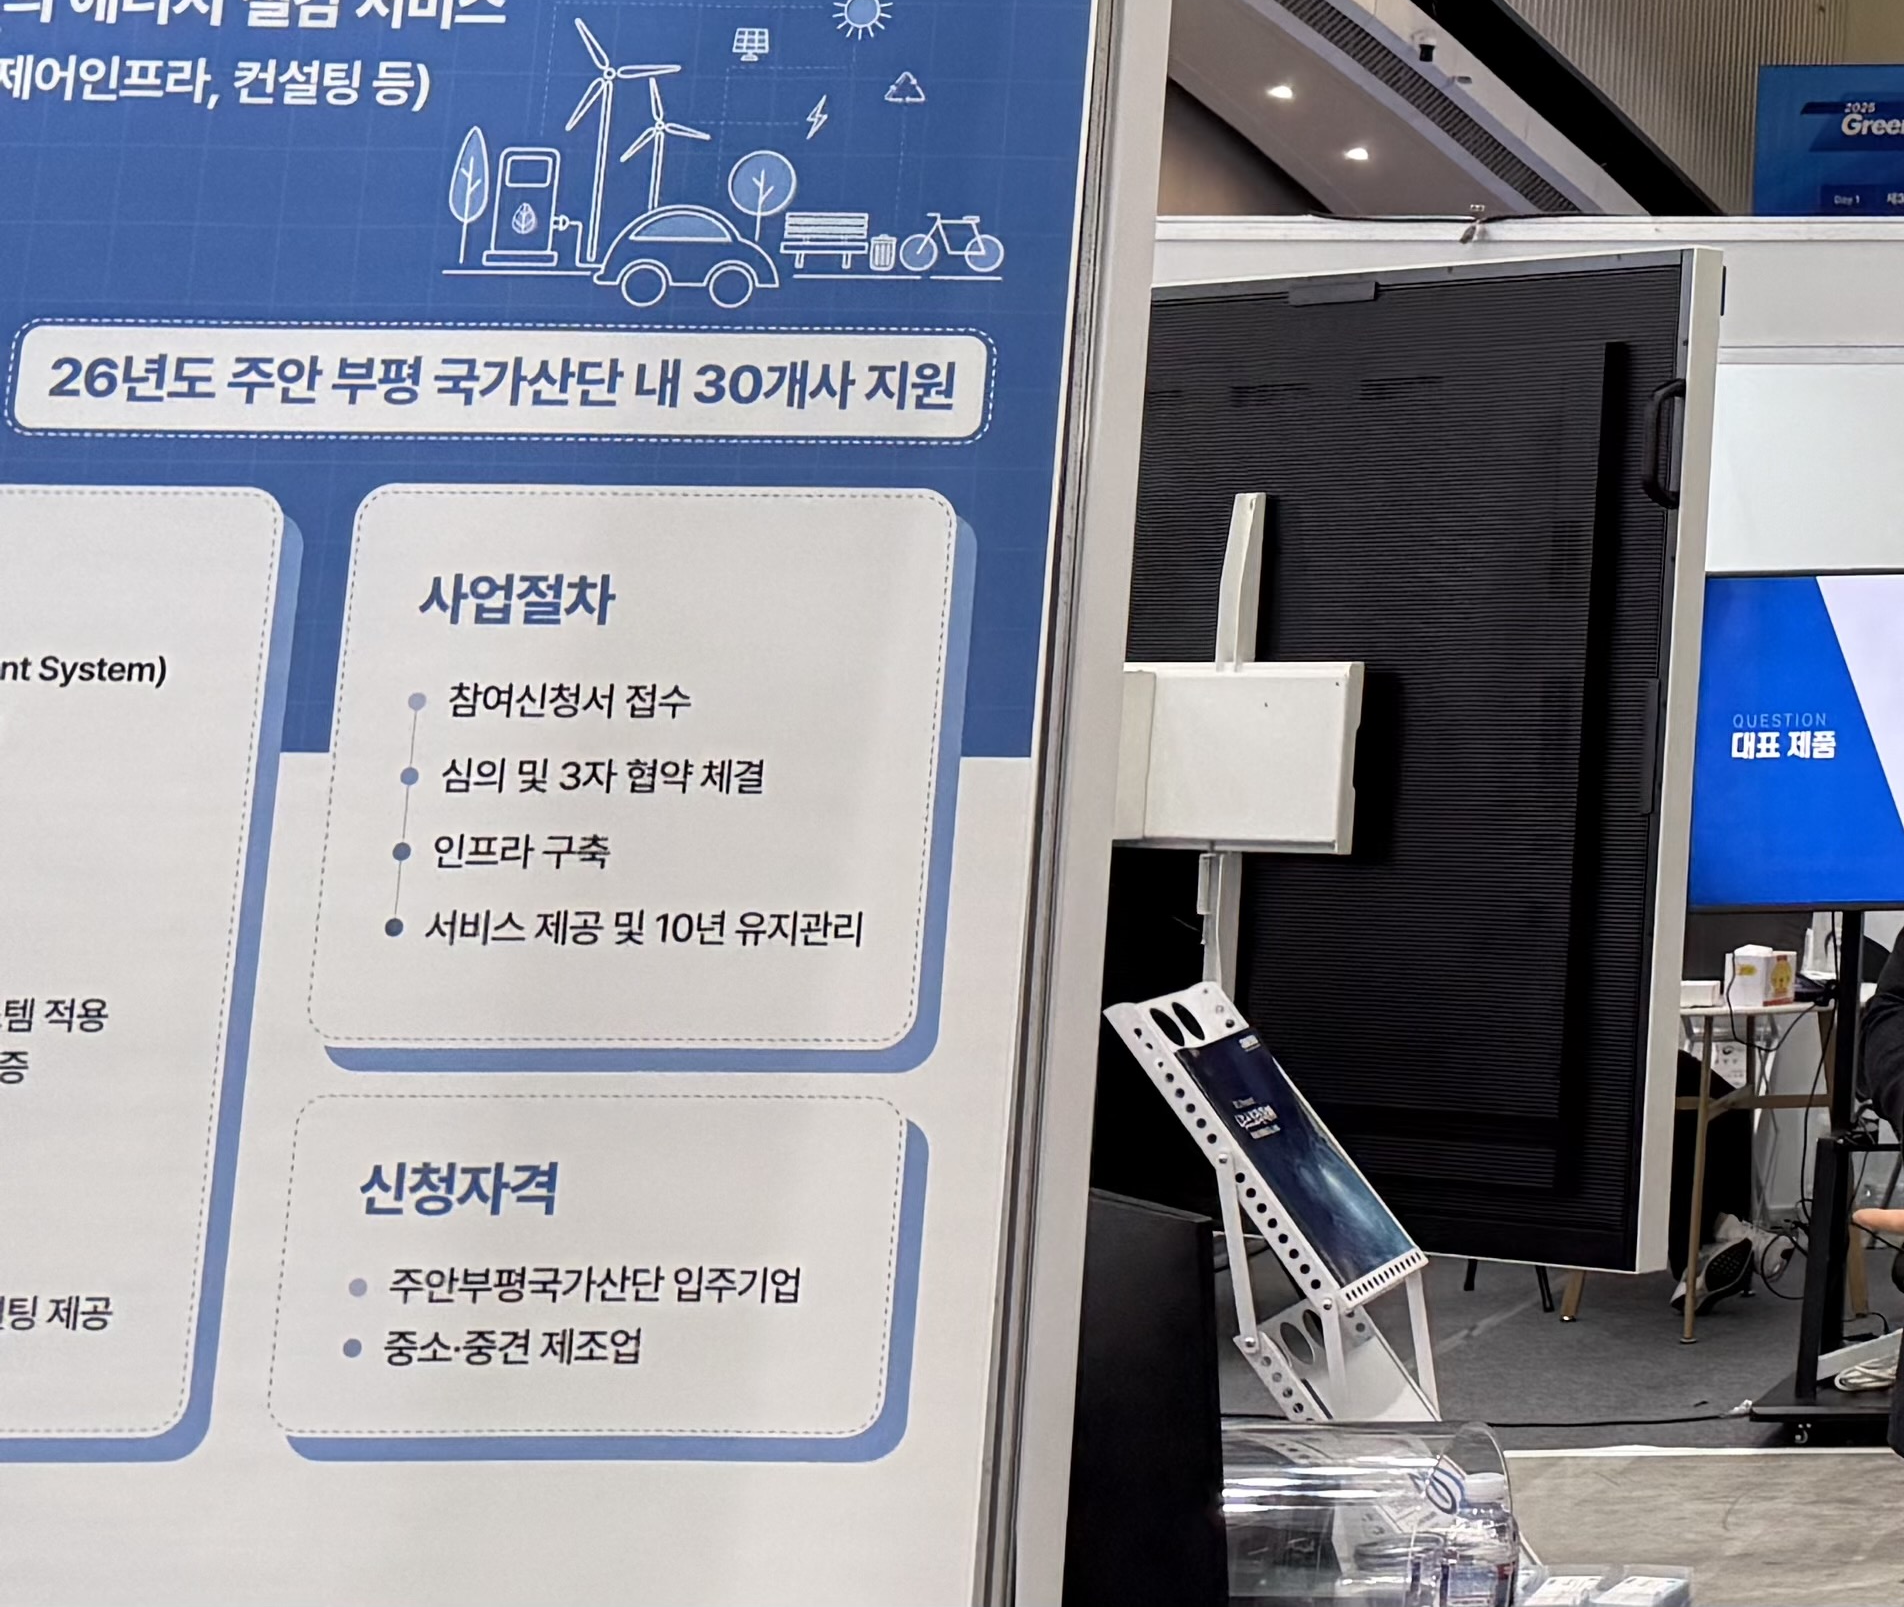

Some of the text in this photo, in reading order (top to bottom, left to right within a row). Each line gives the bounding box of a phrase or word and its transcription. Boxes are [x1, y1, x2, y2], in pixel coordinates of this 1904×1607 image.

[232, 57, 361, 105] 컨설팅
[371, 57, 431, 114] 등)
[49, 355, 955, 410] 26년도 주안 부평 국가산단 내 30개사 지원
[419, 574, 616, 626] 사업절차
[39, 654, 167, 689] System)
[448, 683, 691, 721] 참여신청서 접수
[1733, 713, 1826, 727] QUESTION
[1732, 731, 1836, 760] 대표 제품
[442, 758, 764, 795] 심의 및 3자 협약 체결
[433, 834, 610, 870] 인프라 구축
[425, 909, 863, 947] 서비스 제공 및 10년 유지관리
[44, 998, 108, 1033] 적용
[360, 1162, 557, 1215] 신청자격
[390, 1266, 801, 1306] 주안부평국가산단 입주기업
[46, 1296, 113, 1331] 제공
[384, 1328, 642, 1367] 중소·중견 제조업
